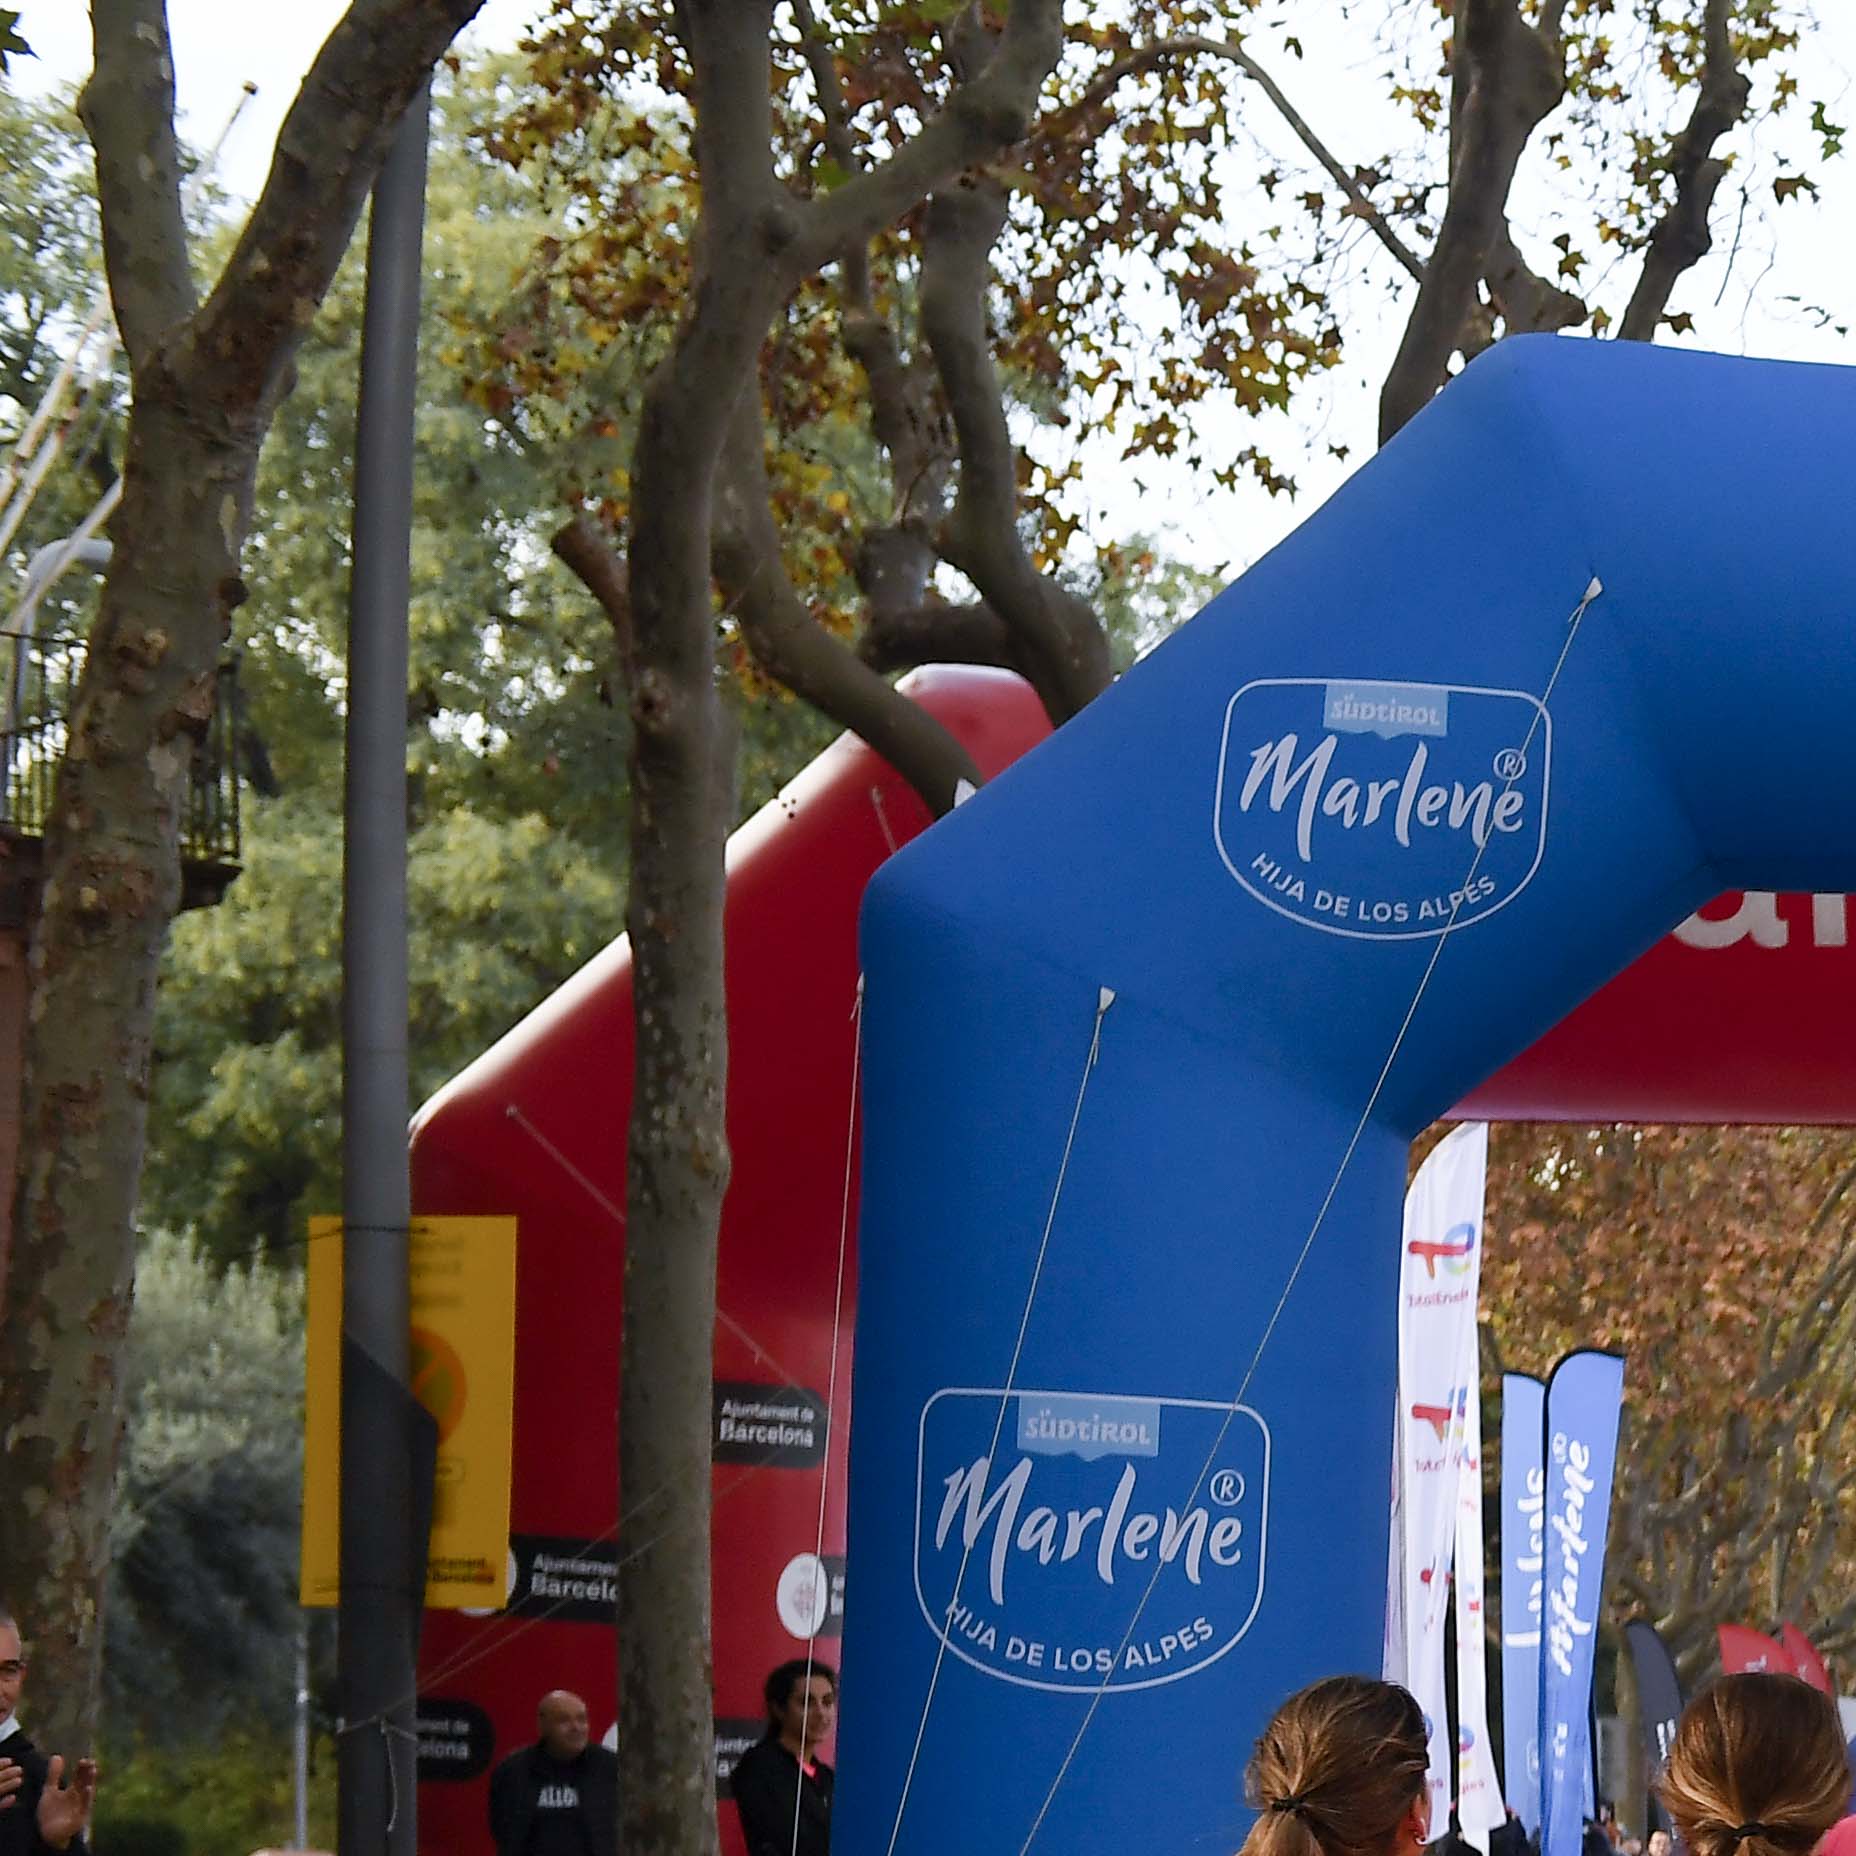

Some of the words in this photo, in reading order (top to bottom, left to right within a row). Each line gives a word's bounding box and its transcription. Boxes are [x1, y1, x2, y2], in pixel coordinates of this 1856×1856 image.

[1250, 852, 1307, 903] HIJA
[1311, 889, 1351, 919] DE
[1357, 900, 1410, 922] LOS
[1417, 875, 1496, 921] ALPES
[719, 1418, 815, 1449] Barcelona
[944, 1599, 998, 1651] HIJA
[1004, 1635, 1046, 1668] DE
[1053, 1646, 1115, 1673] LOS
[1124, 1615, 1214, 1670] ALPES
